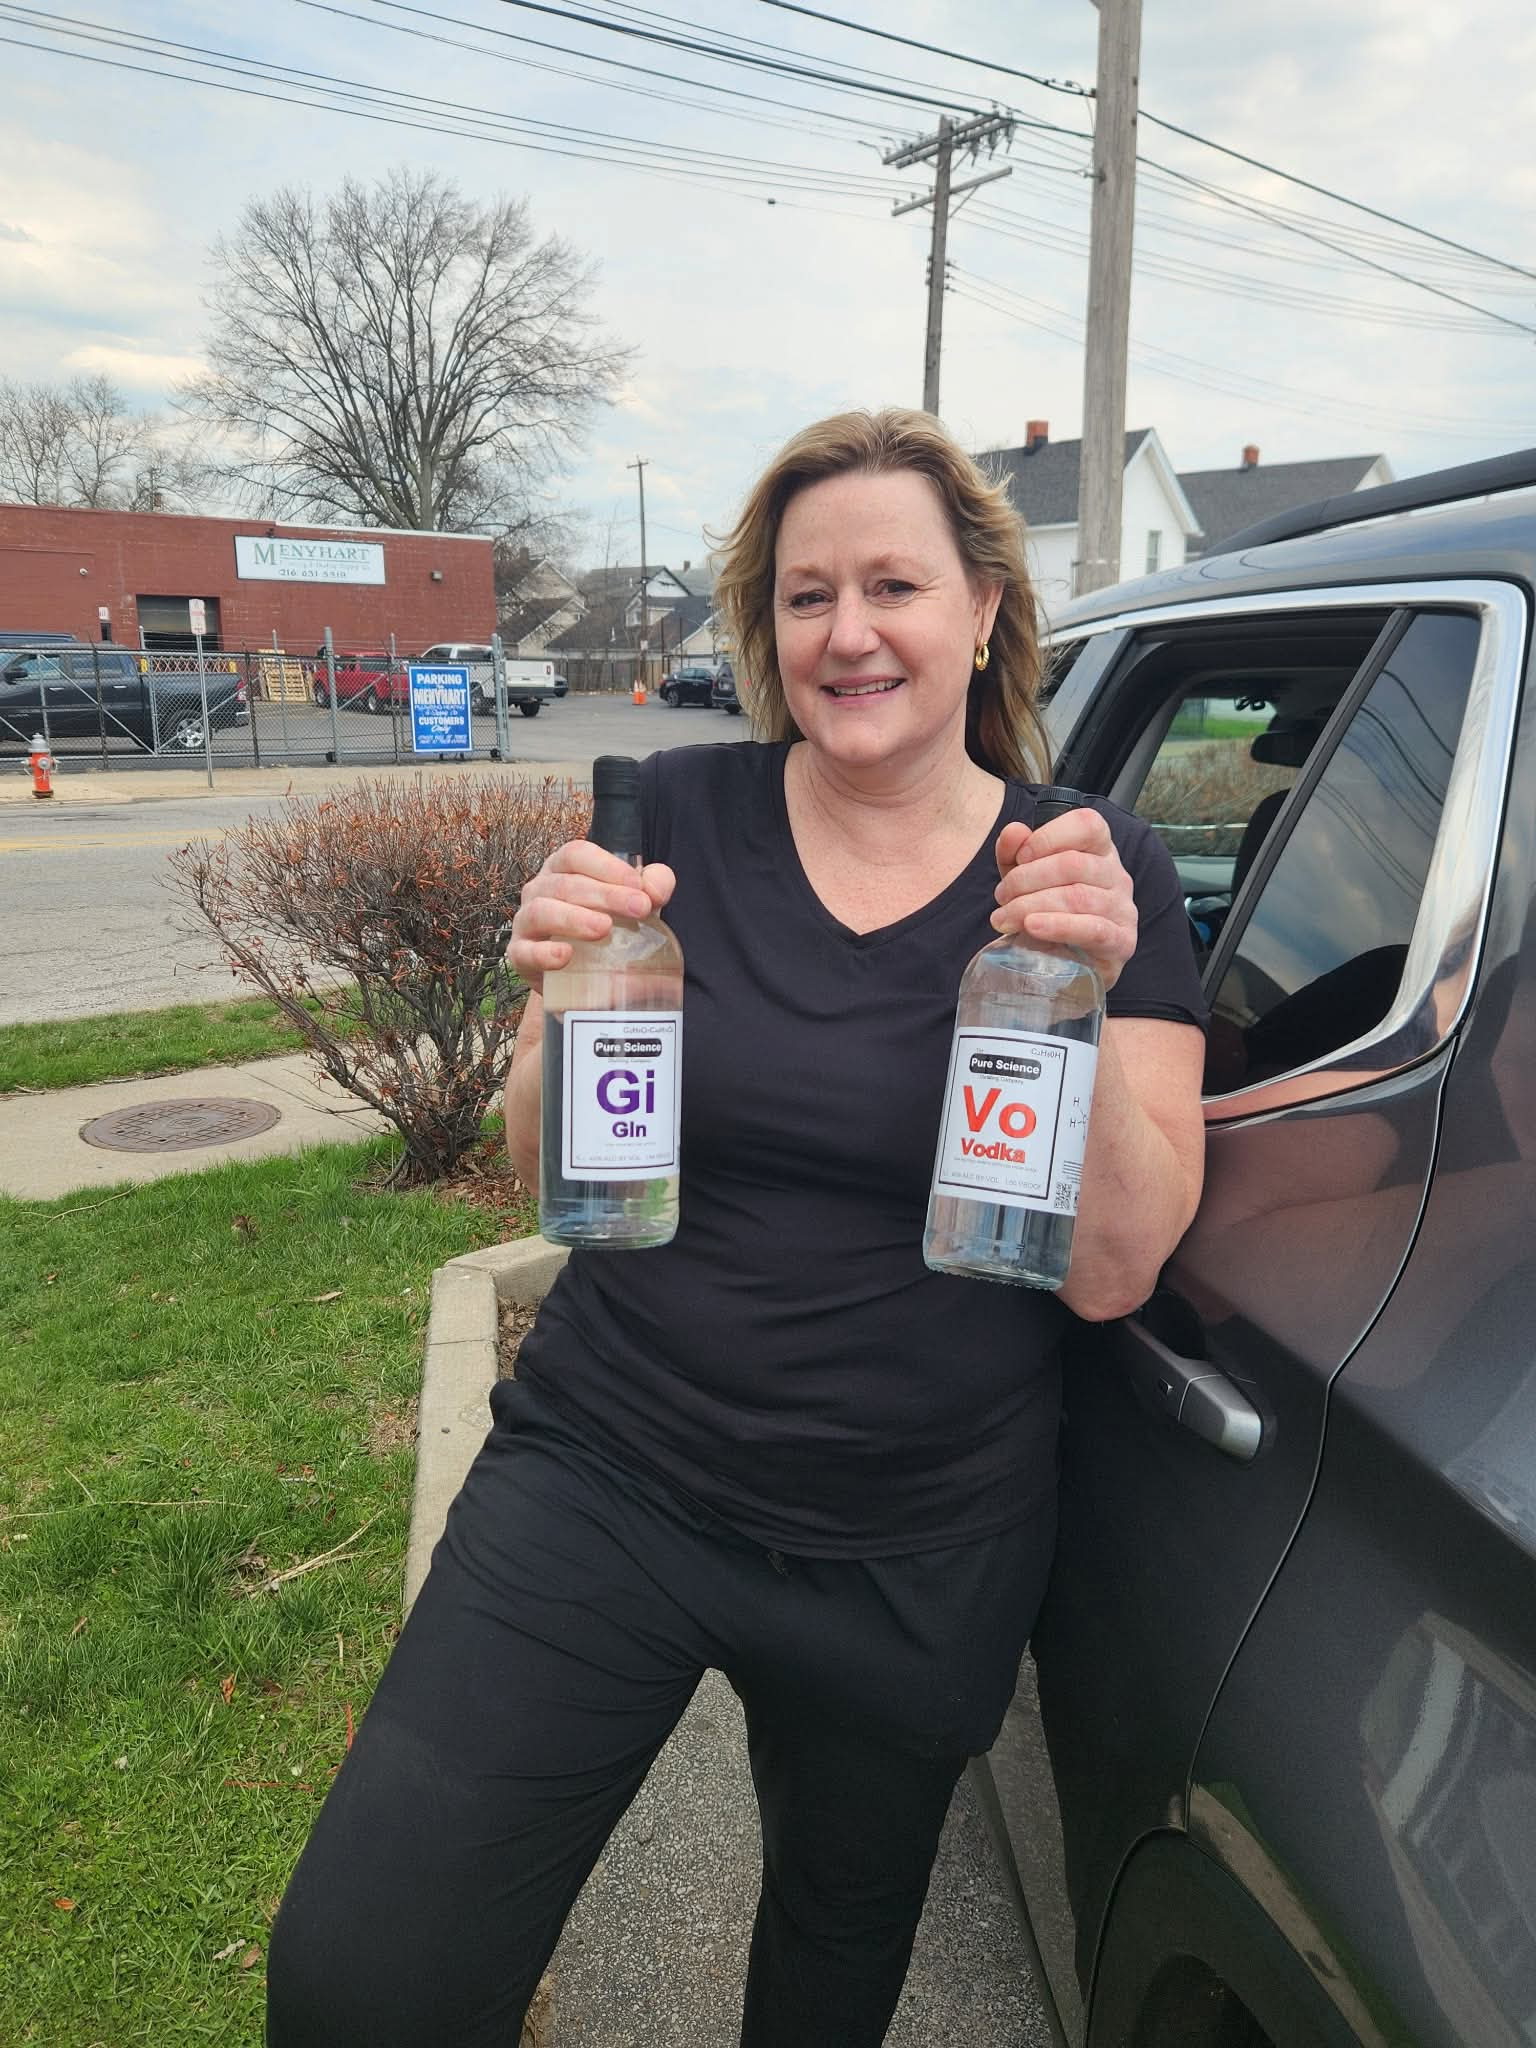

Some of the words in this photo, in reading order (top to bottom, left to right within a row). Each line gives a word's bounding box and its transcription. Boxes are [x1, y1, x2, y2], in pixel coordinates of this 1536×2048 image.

[254, 543, 369, 565] MENYHART
[279, 568, 296, 577] 216
[416, 673, 463, 685] PARKING
[413, 688, 467, 705] MENYHART
[418, 716, 465, 726] CUSTOMERS
[595, 1042, 621, 1053] Pure
[623, 1042, 662, 1053] Science
[971, 1057, 994, 1069] Pure
[995, 1059, 1040, 1075] Science
[596, 1069, 655, 1115] Gi
[963, 1085, 1037, 1138] Vo
[612, 1121, 647, 1138] Gin
[961, 1137, 1026, 1164] Vodka
